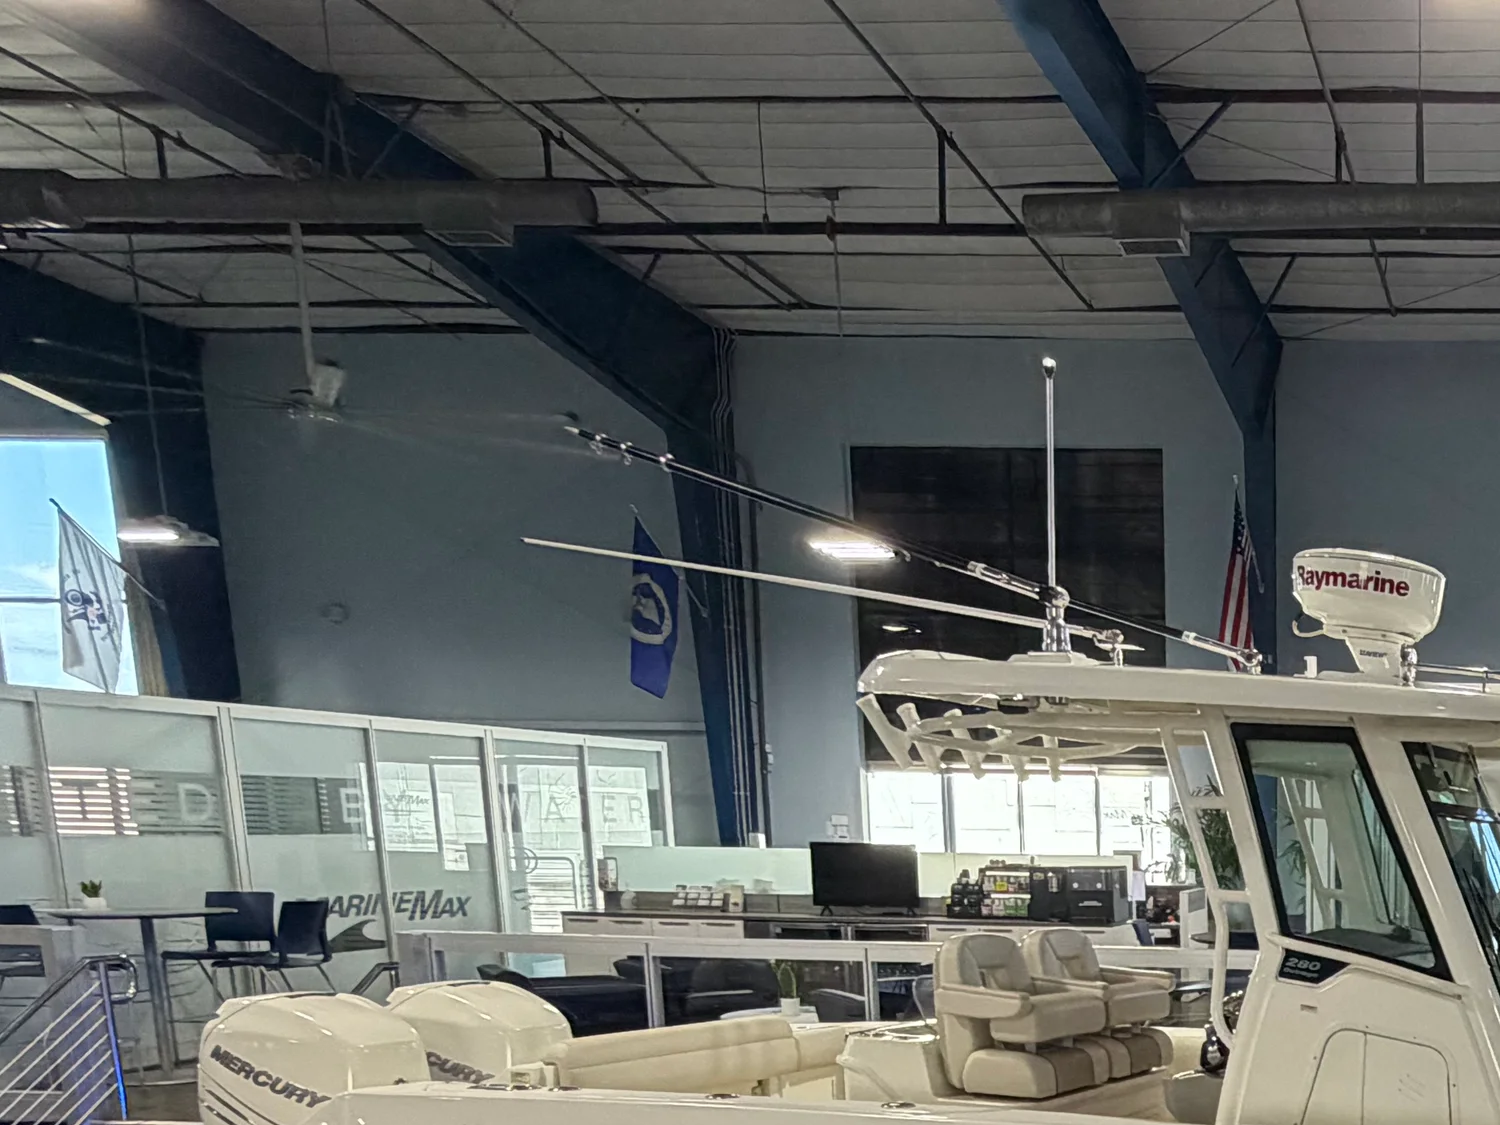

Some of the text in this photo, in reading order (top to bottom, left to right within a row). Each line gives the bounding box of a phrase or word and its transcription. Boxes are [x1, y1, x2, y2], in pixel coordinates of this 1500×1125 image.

[1297, 565, 1410, 597] Raymarine
[500, 784, 647, 824] WAER
[1285, 957, 1321, 971] 280
[210, 1045, 332, 1108] MERCURY
[426, 1051, 495, 1084] CURY
